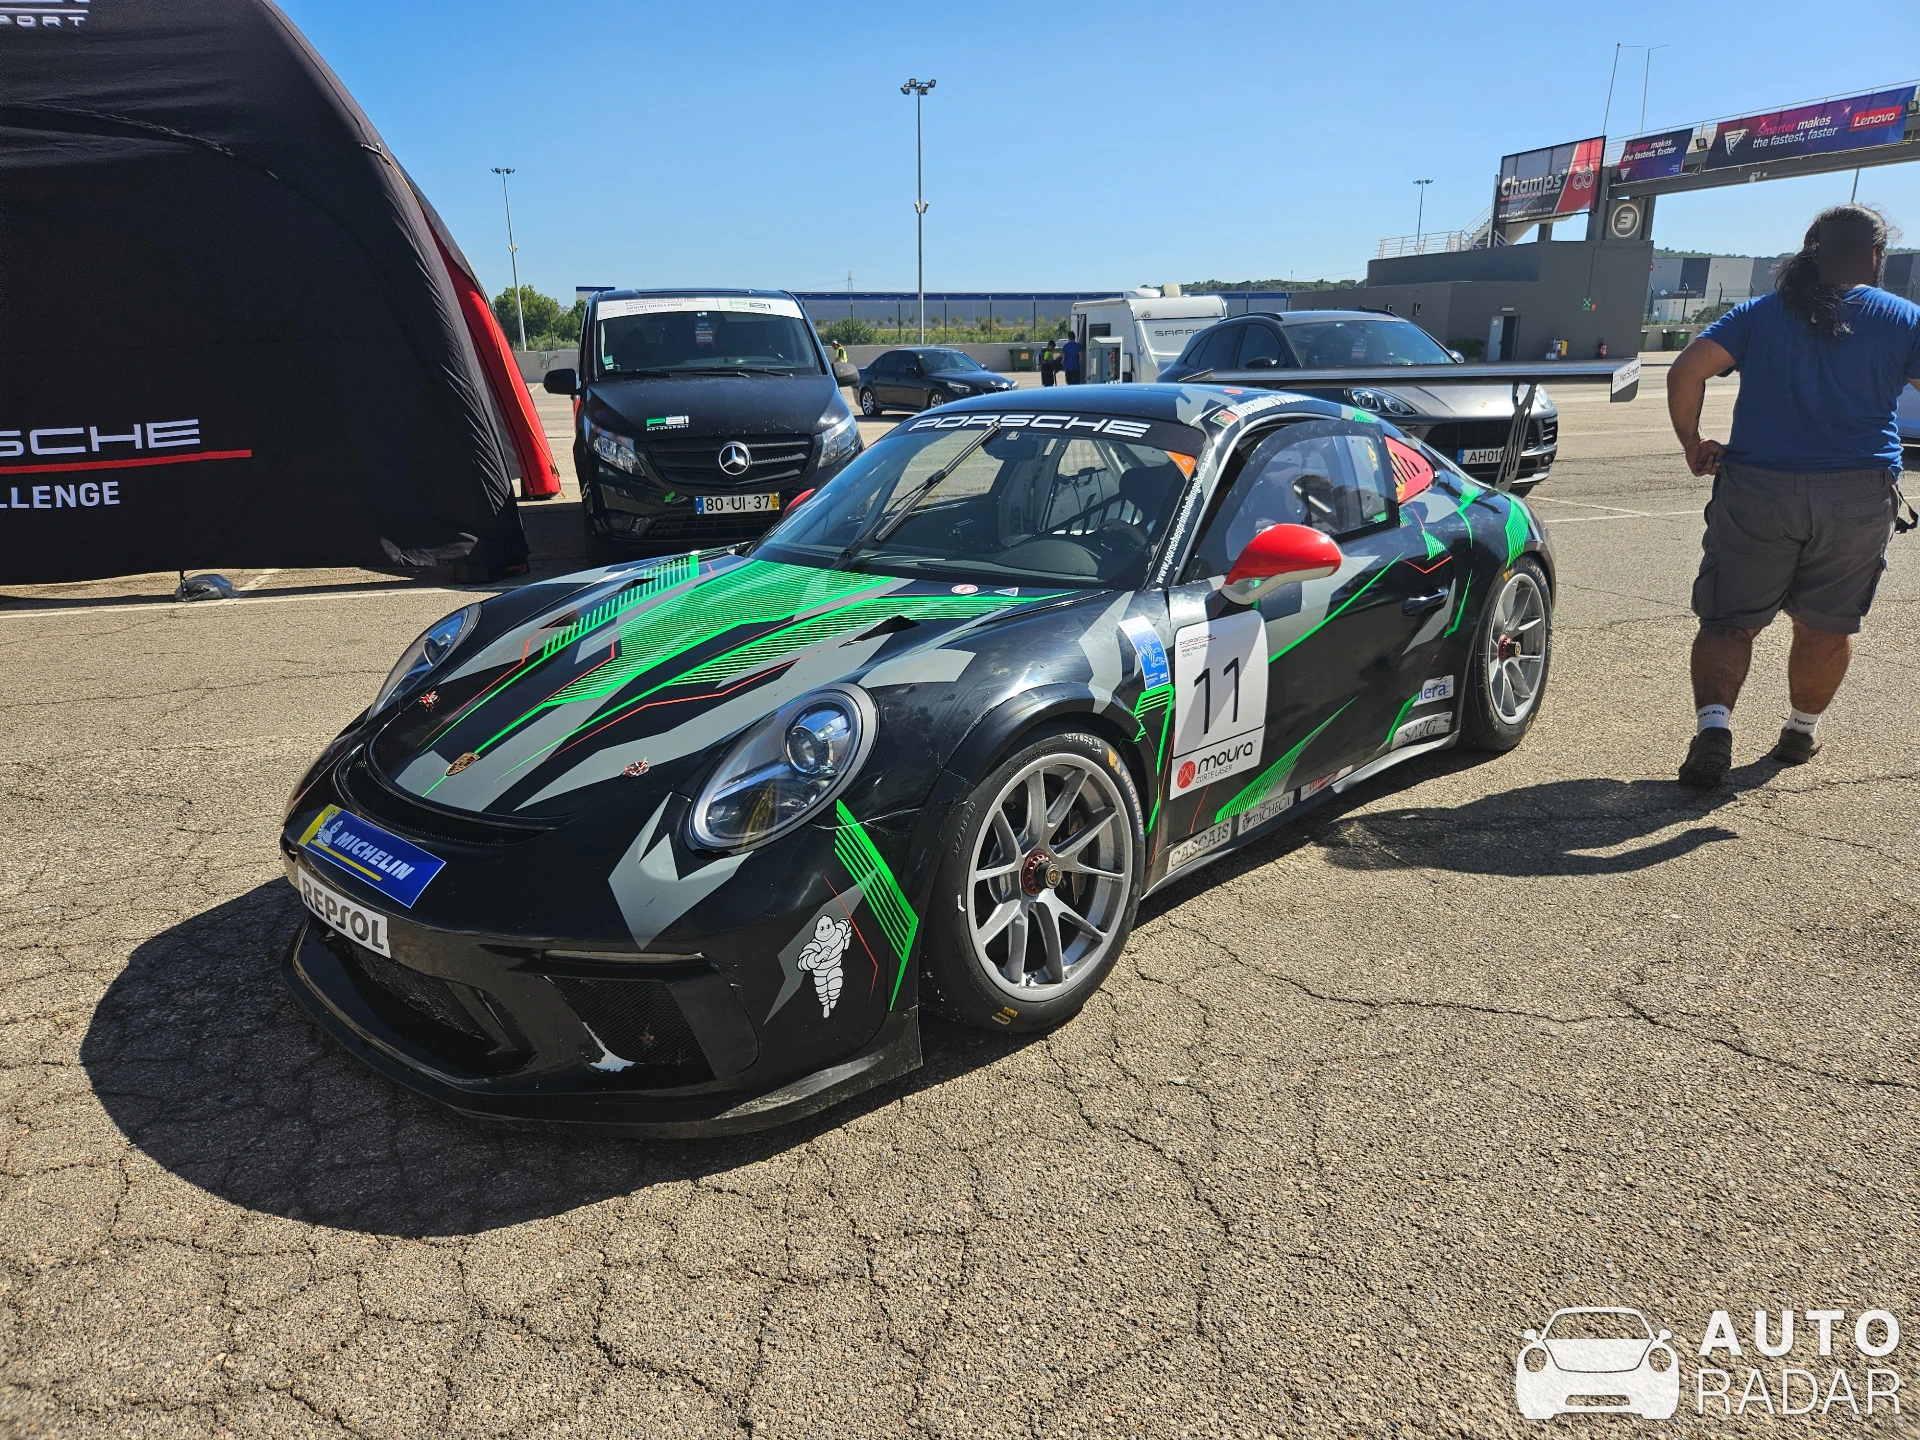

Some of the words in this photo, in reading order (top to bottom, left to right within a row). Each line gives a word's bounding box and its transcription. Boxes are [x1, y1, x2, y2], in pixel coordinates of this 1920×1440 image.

[1757, 122, 1795, 136] Smarter
[1797, 116, 1831, 130] makes
[1854, 112, 1896, 127] Lenovo
[1650, 140, 1672, 150] makes
[1753, 138, 1768, 149] the
[1770, 132, 1805, 146] fastest,
[1808, 127, 1838, 140] faster
[1623, 154, 1634, 162] the
[1657, 147, 1676, 156] faster
[1501, 174, 1562, 196] Champs
[1617, 212, 1634, 230] 3
[908, 414, 1152, 439] PORSCHE
[1193, 657, 1239, 735] 11
[1197, 741, 1253, 774] moura
[1195, 772, 1215, 783] CORTE
[1215, 764, 1233, 777] LASER
[1121, 770, 1144, 835] MICHELIN
[1171, 822, 1230, 867] CASCAIS
[333, 831, 416, 881] MICHELIN
[302, 877, 384, 950] REPSOL
